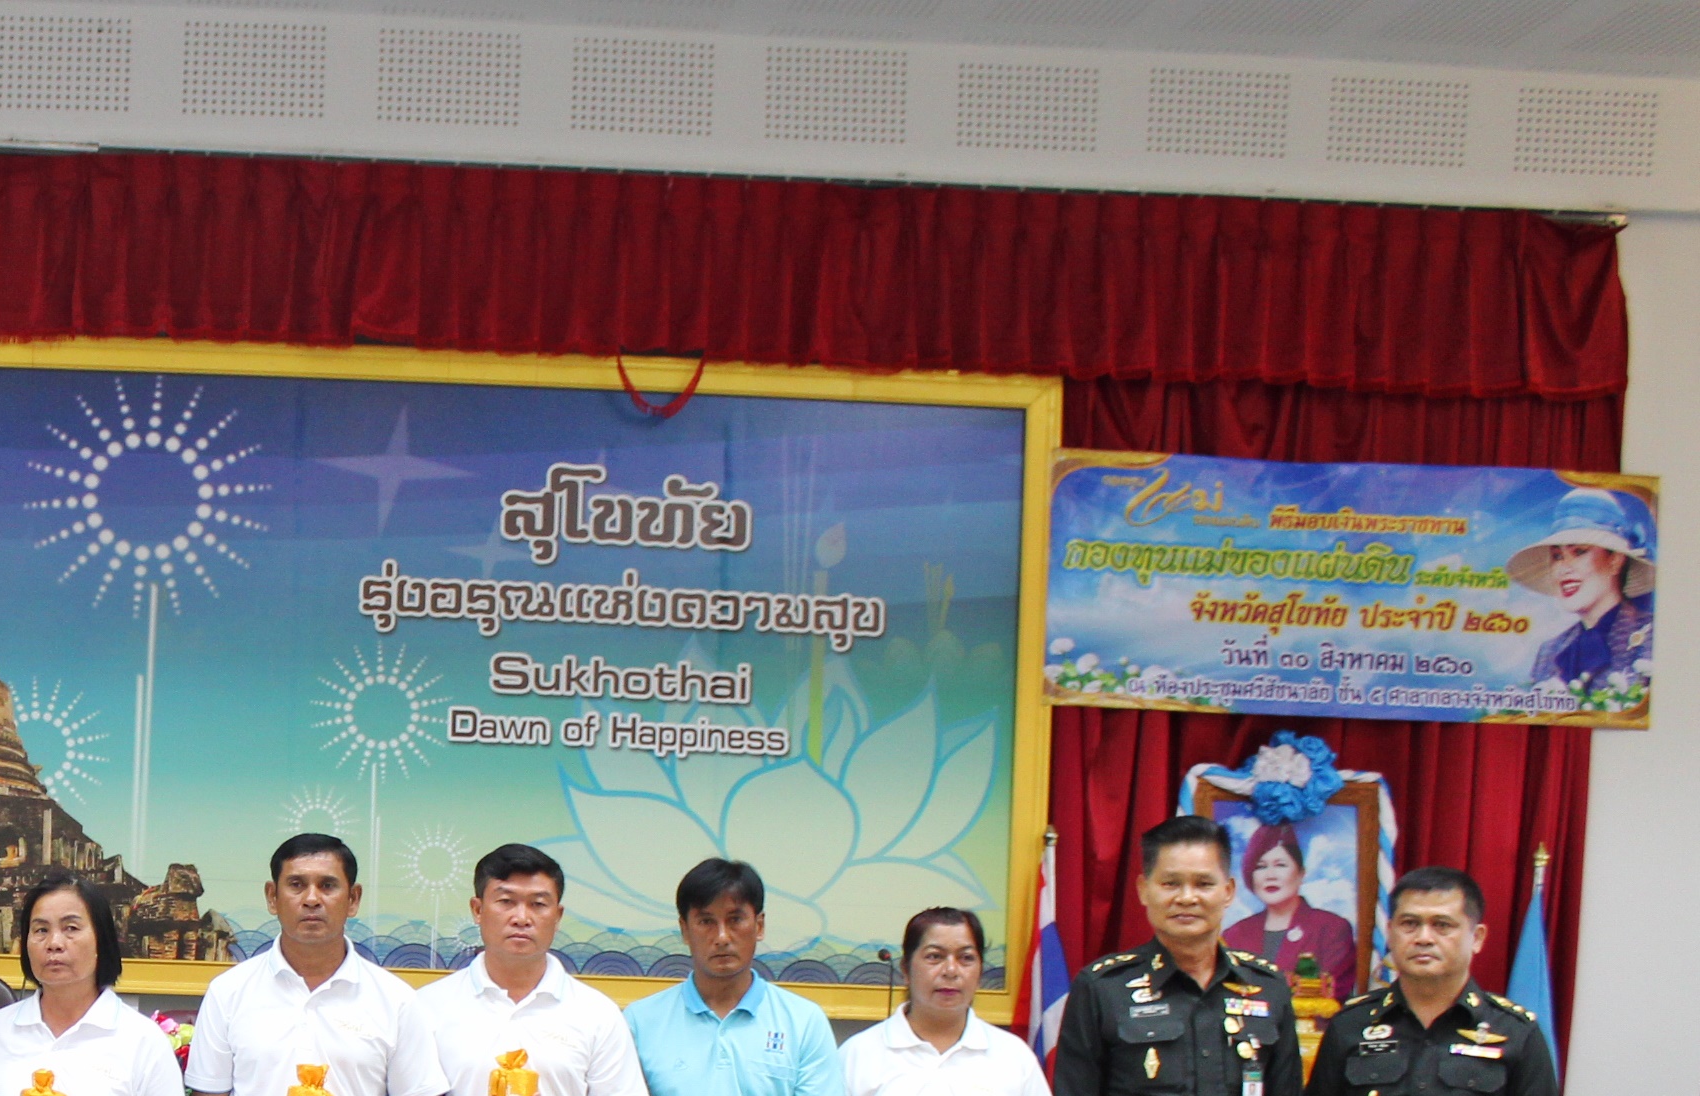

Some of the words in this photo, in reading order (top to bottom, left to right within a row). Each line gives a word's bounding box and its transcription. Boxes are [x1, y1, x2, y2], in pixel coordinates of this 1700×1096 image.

[502, 464, 752, 563] สุโขทัย
[1269, 505, 1468, 535] พิธีมอบเงินพระราชทาน
[1063, 538, 1414, 585] กองทุนแม่ของแผ่นดิน
[360, 562, 886, 650] รุ่งอรุณแห่งความสุข
[1189, 592, 1348, 635] จังหวัดสุโขทัย
[1358, 594, 1457, 632] ประจำปี
[1221, 634, 1269, 667] วันที่
[1319, 642, 1404, 673] สิงหาคม
[492, 656, 751, 702] Sukhothai
[450, 710, 548, 745] Dawn
[563, 711, 599, 746] of
[611, 717, 787, 757] Happiness
